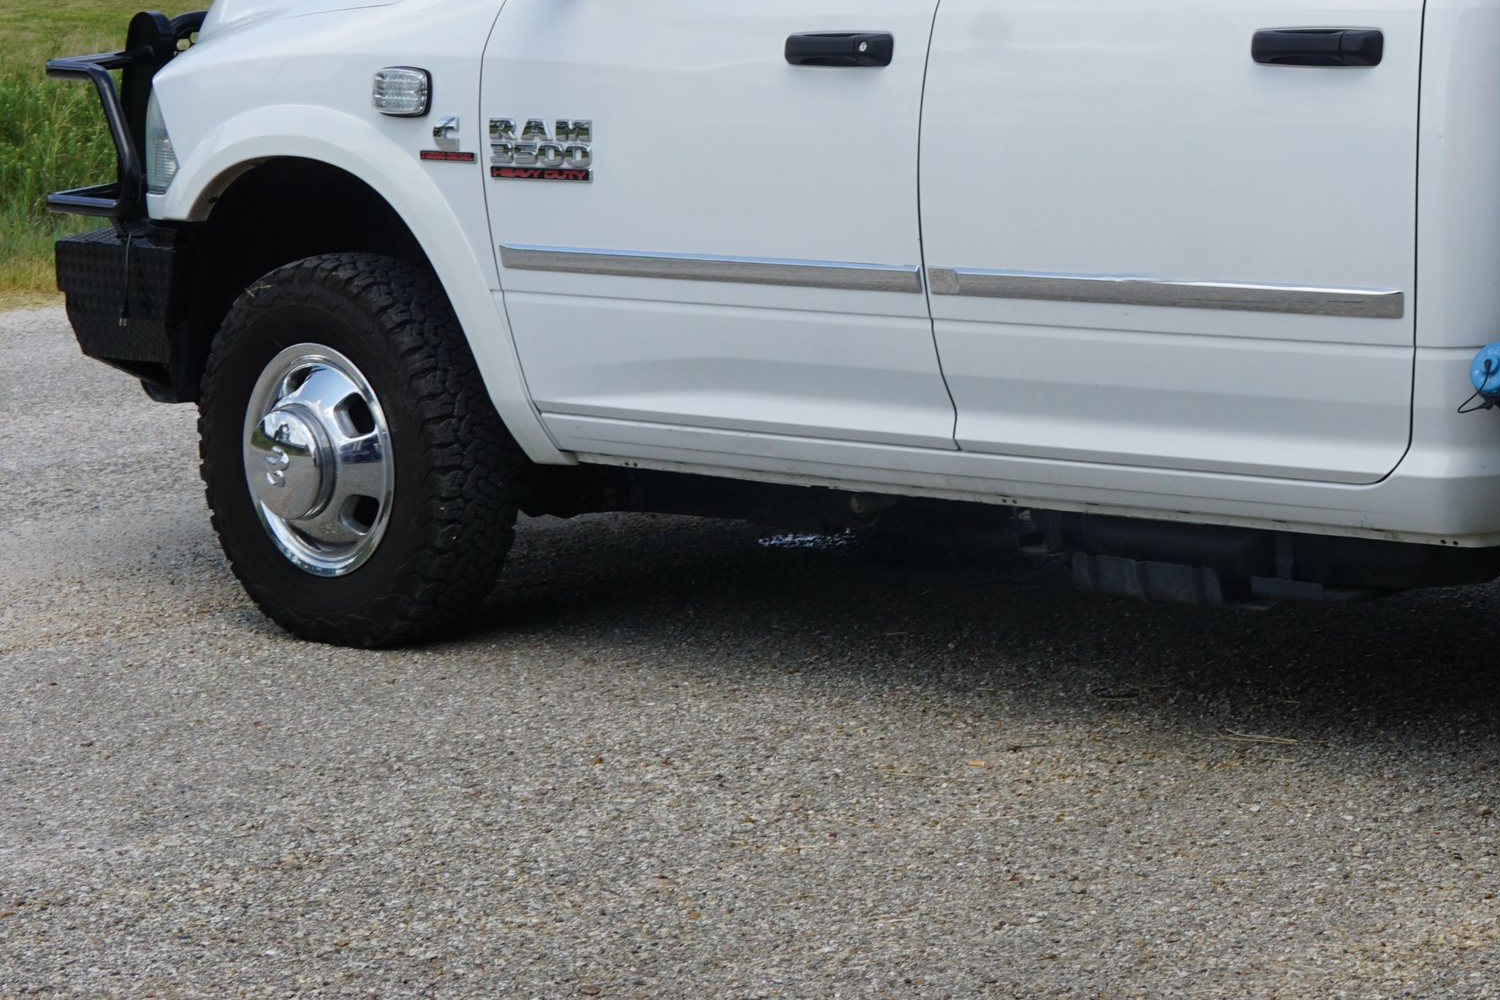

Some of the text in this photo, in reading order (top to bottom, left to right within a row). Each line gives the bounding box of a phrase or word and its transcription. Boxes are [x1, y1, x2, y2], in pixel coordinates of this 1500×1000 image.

[489, 118, 592, 142] RAM
[490, 141, 592, 167] 3500
[492, 168, 586, 180] HEAVY DUTY
